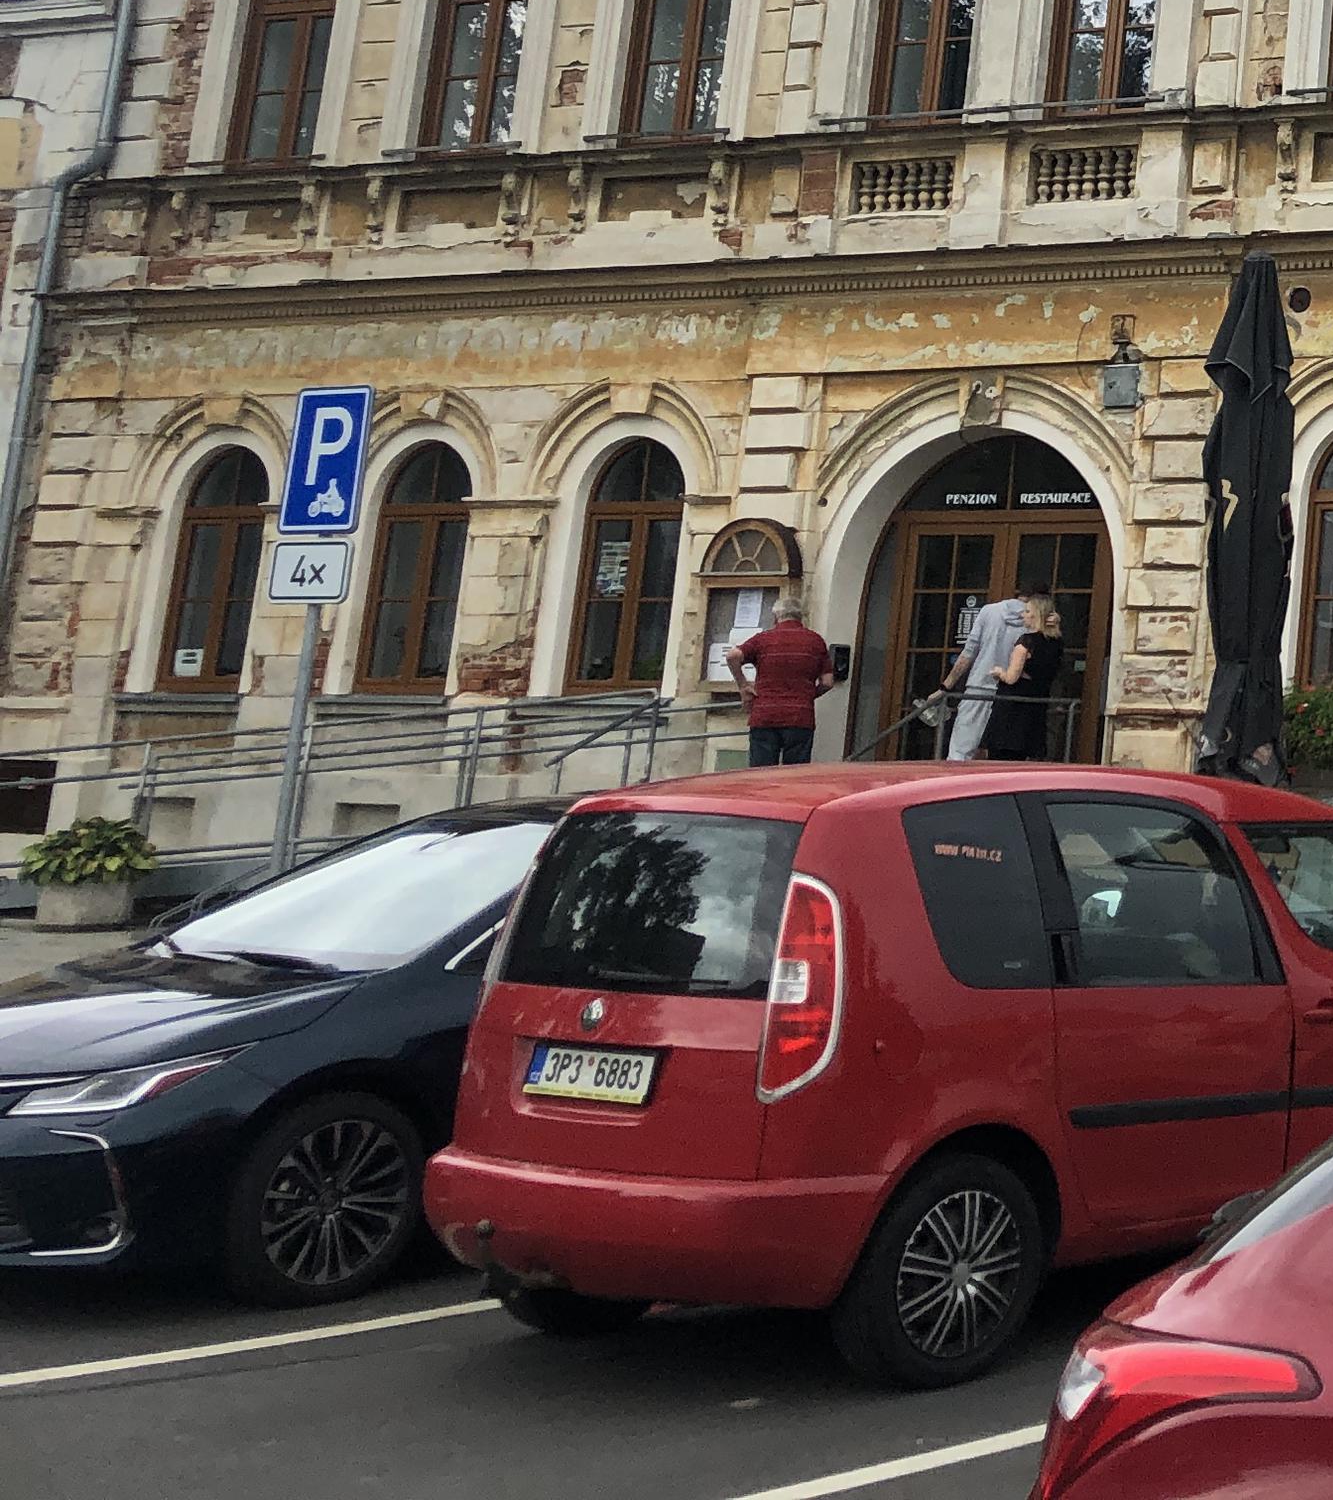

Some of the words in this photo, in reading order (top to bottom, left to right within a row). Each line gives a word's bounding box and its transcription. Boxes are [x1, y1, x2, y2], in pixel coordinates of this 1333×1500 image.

[304, 406, 353, 486] P
[945, 493, 998, 505] PENZION
[1019, 492, 1092, 504] RESTAURACE
[545, 1052, 583, 1084] 3P3
[593, 1057, 643, 1090] 6883
